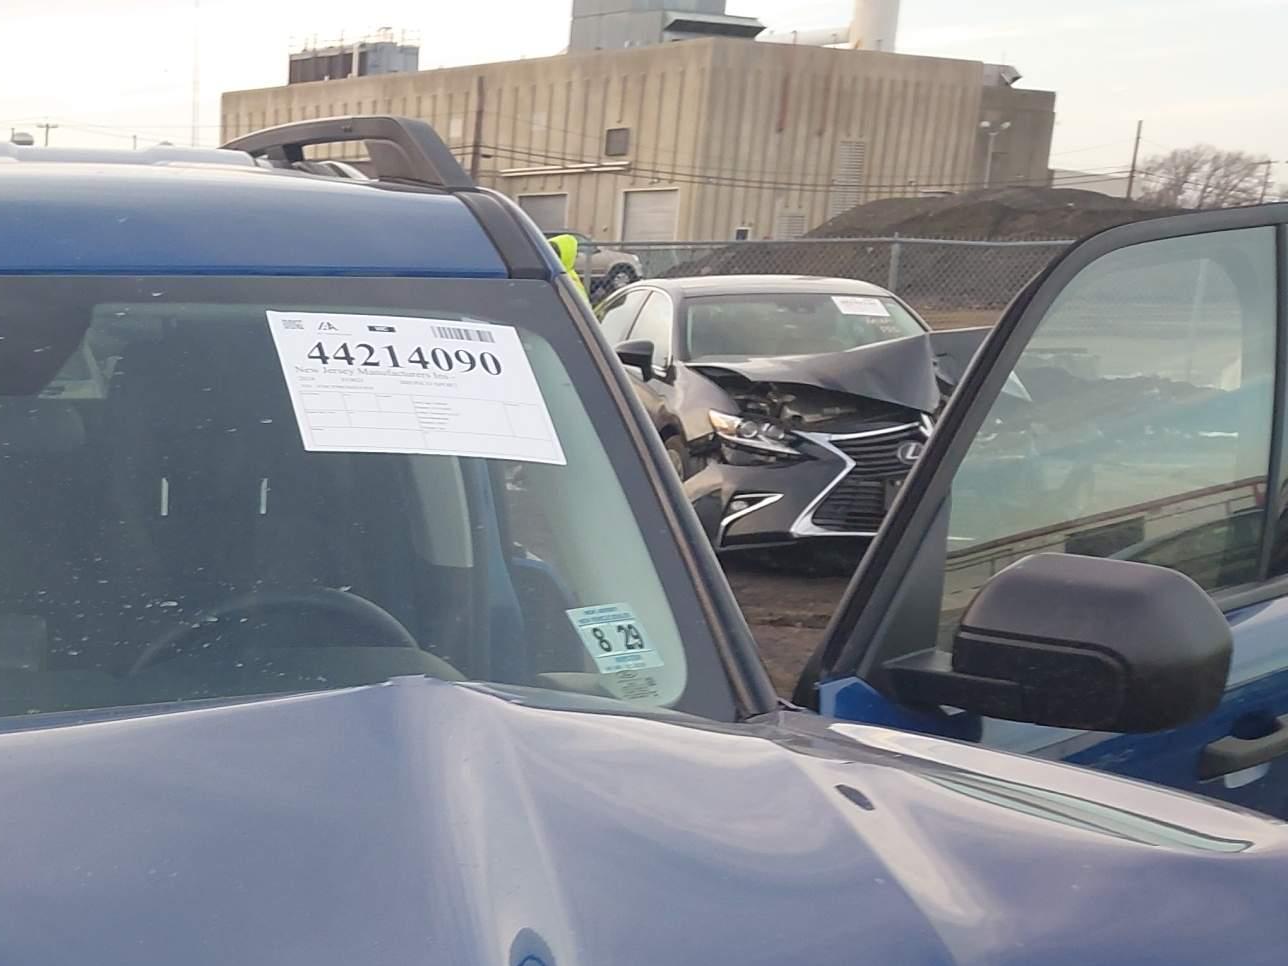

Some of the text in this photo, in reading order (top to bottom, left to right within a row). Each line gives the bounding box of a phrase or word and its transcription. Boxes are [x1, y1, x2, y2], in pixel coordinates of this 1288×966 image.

[294, 366, 317, 375] New
[323, 367, 354, 377] Jersey
[307, 341, 503, 377] 44214090
[592, 624, 645, 652] 8 29
